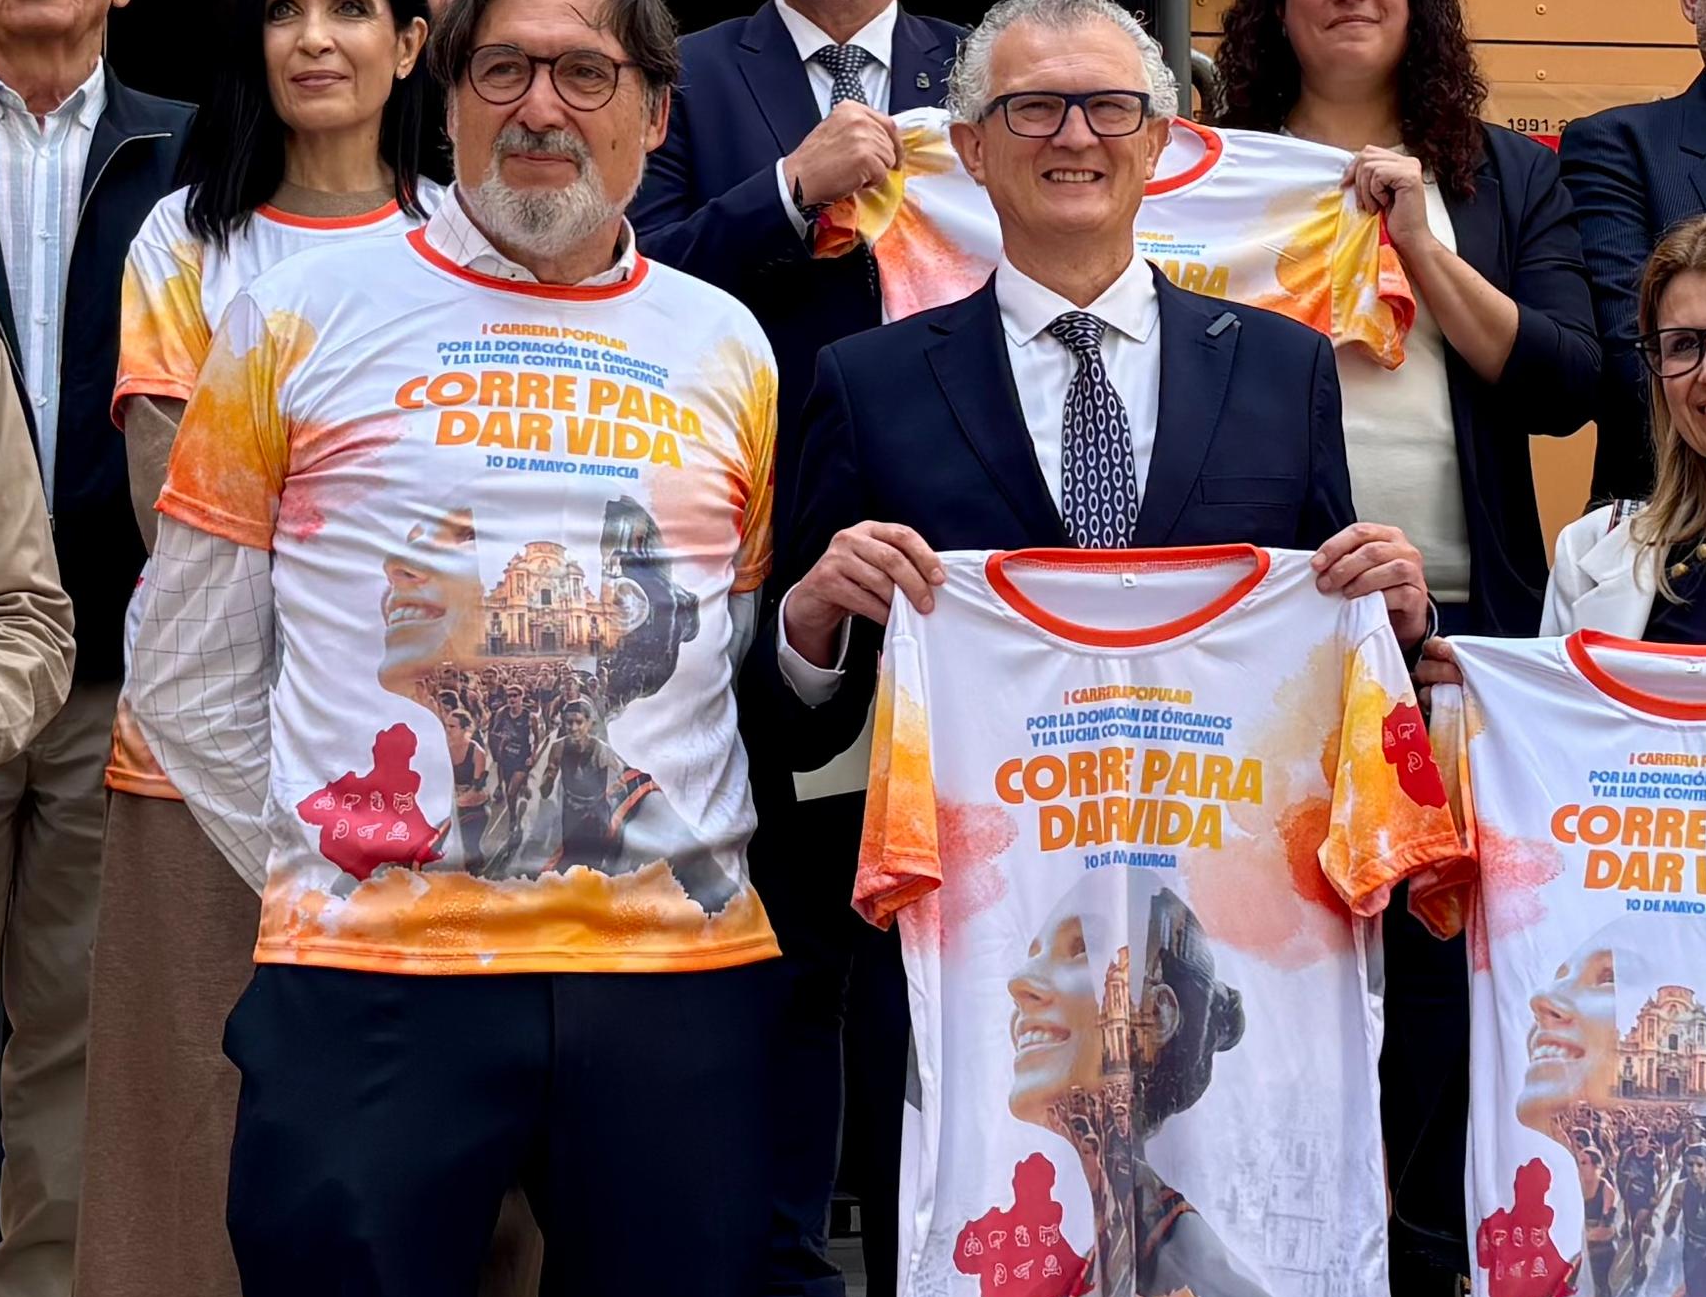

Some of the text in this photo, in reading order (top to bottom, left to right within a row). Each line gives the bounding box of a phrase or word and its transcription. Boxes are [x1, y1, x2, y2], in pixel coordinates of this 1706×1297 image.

[1149, 257, 1230, 297] ARA
[491, 323, 559, 339] CARRERA
[562, 327, 628, 351] POPULAR
[437, 341, 669, 379] POR LA DONACIÓN DE ÓRGANOS
[442, 352, 665, 389] Y LA LUCHA CONTRA LA LEUCEMIA
[395, 370, 707, 443] CORRE PARA
[435, 409, 684, 469] DAR VIDA
[486, 455, 639, 479] 10 DE MAYO MURCIA
[1139, 749, 1263, 805] PARA
[1589, 771, 1620, 783] POR
[1622, 771, 1637, 783] LA
[1637, 753, 1699, 768] CARRERA
[1592, 785, 1600, 797] Y
[1602, 785, 1619, 798] LA
[1621, 785, 1661, 800] LUCHA
[1039, 797, 1223, 851] DAR VIDA
[1583, 849, 1685, 893] DAR
[1626, 899, 1641, 912] 10
[1643, 899, 1661, 912] DE
[1663, 901, 1705, 915] MAYO
